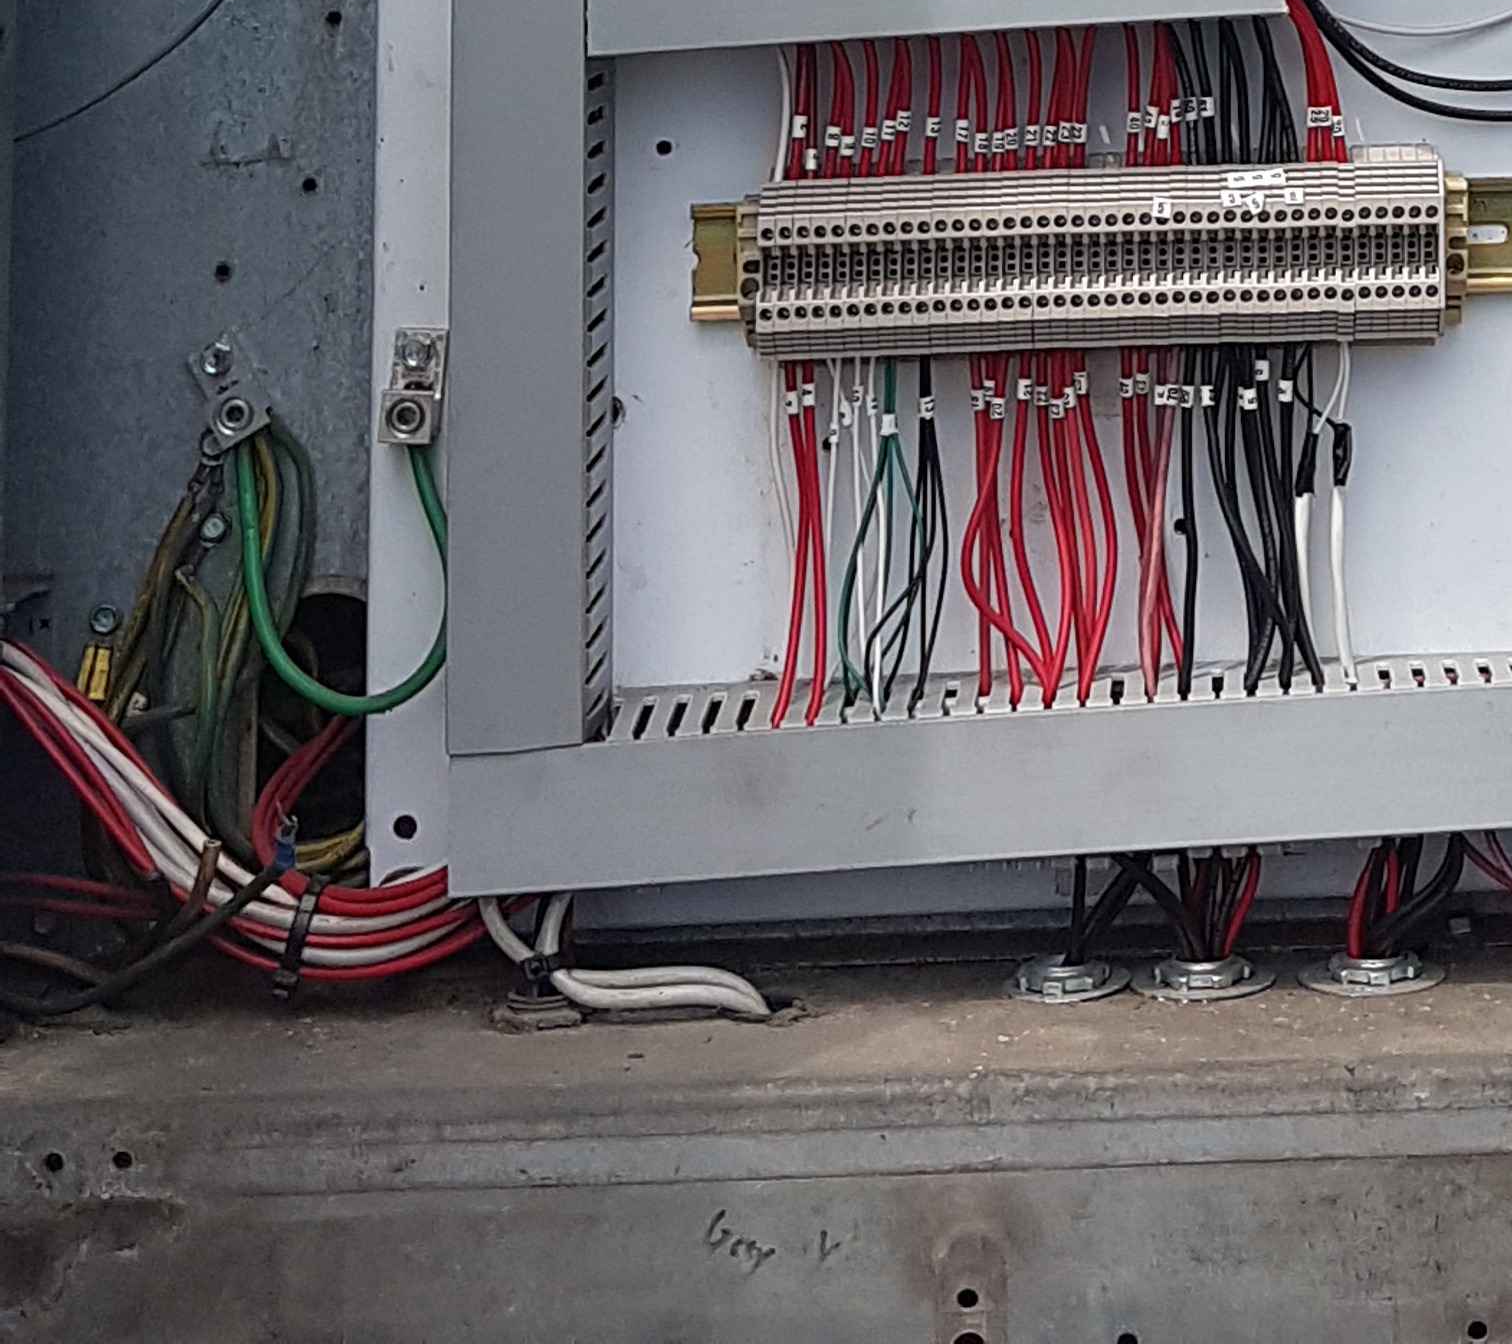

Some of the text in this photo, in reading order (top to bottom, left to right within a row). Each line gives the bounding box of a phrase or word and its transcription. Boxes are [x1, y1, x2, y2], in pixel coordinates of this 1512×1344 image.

[899, 115, 911, 128] 12
[1129, 118, 1140, 130] 40
[884, 125, 895, 136] 11
[958, 126, 969, 140] 17
[1026, 129, 1038, 142] 21
[864, 132, 876, 143] 10
[1006, 133, 1017, 146] 20
[978, 138, 989, 150] 18
[1157, 202, 1164, 213] 5
[992, 403, 1003, 416] 20
